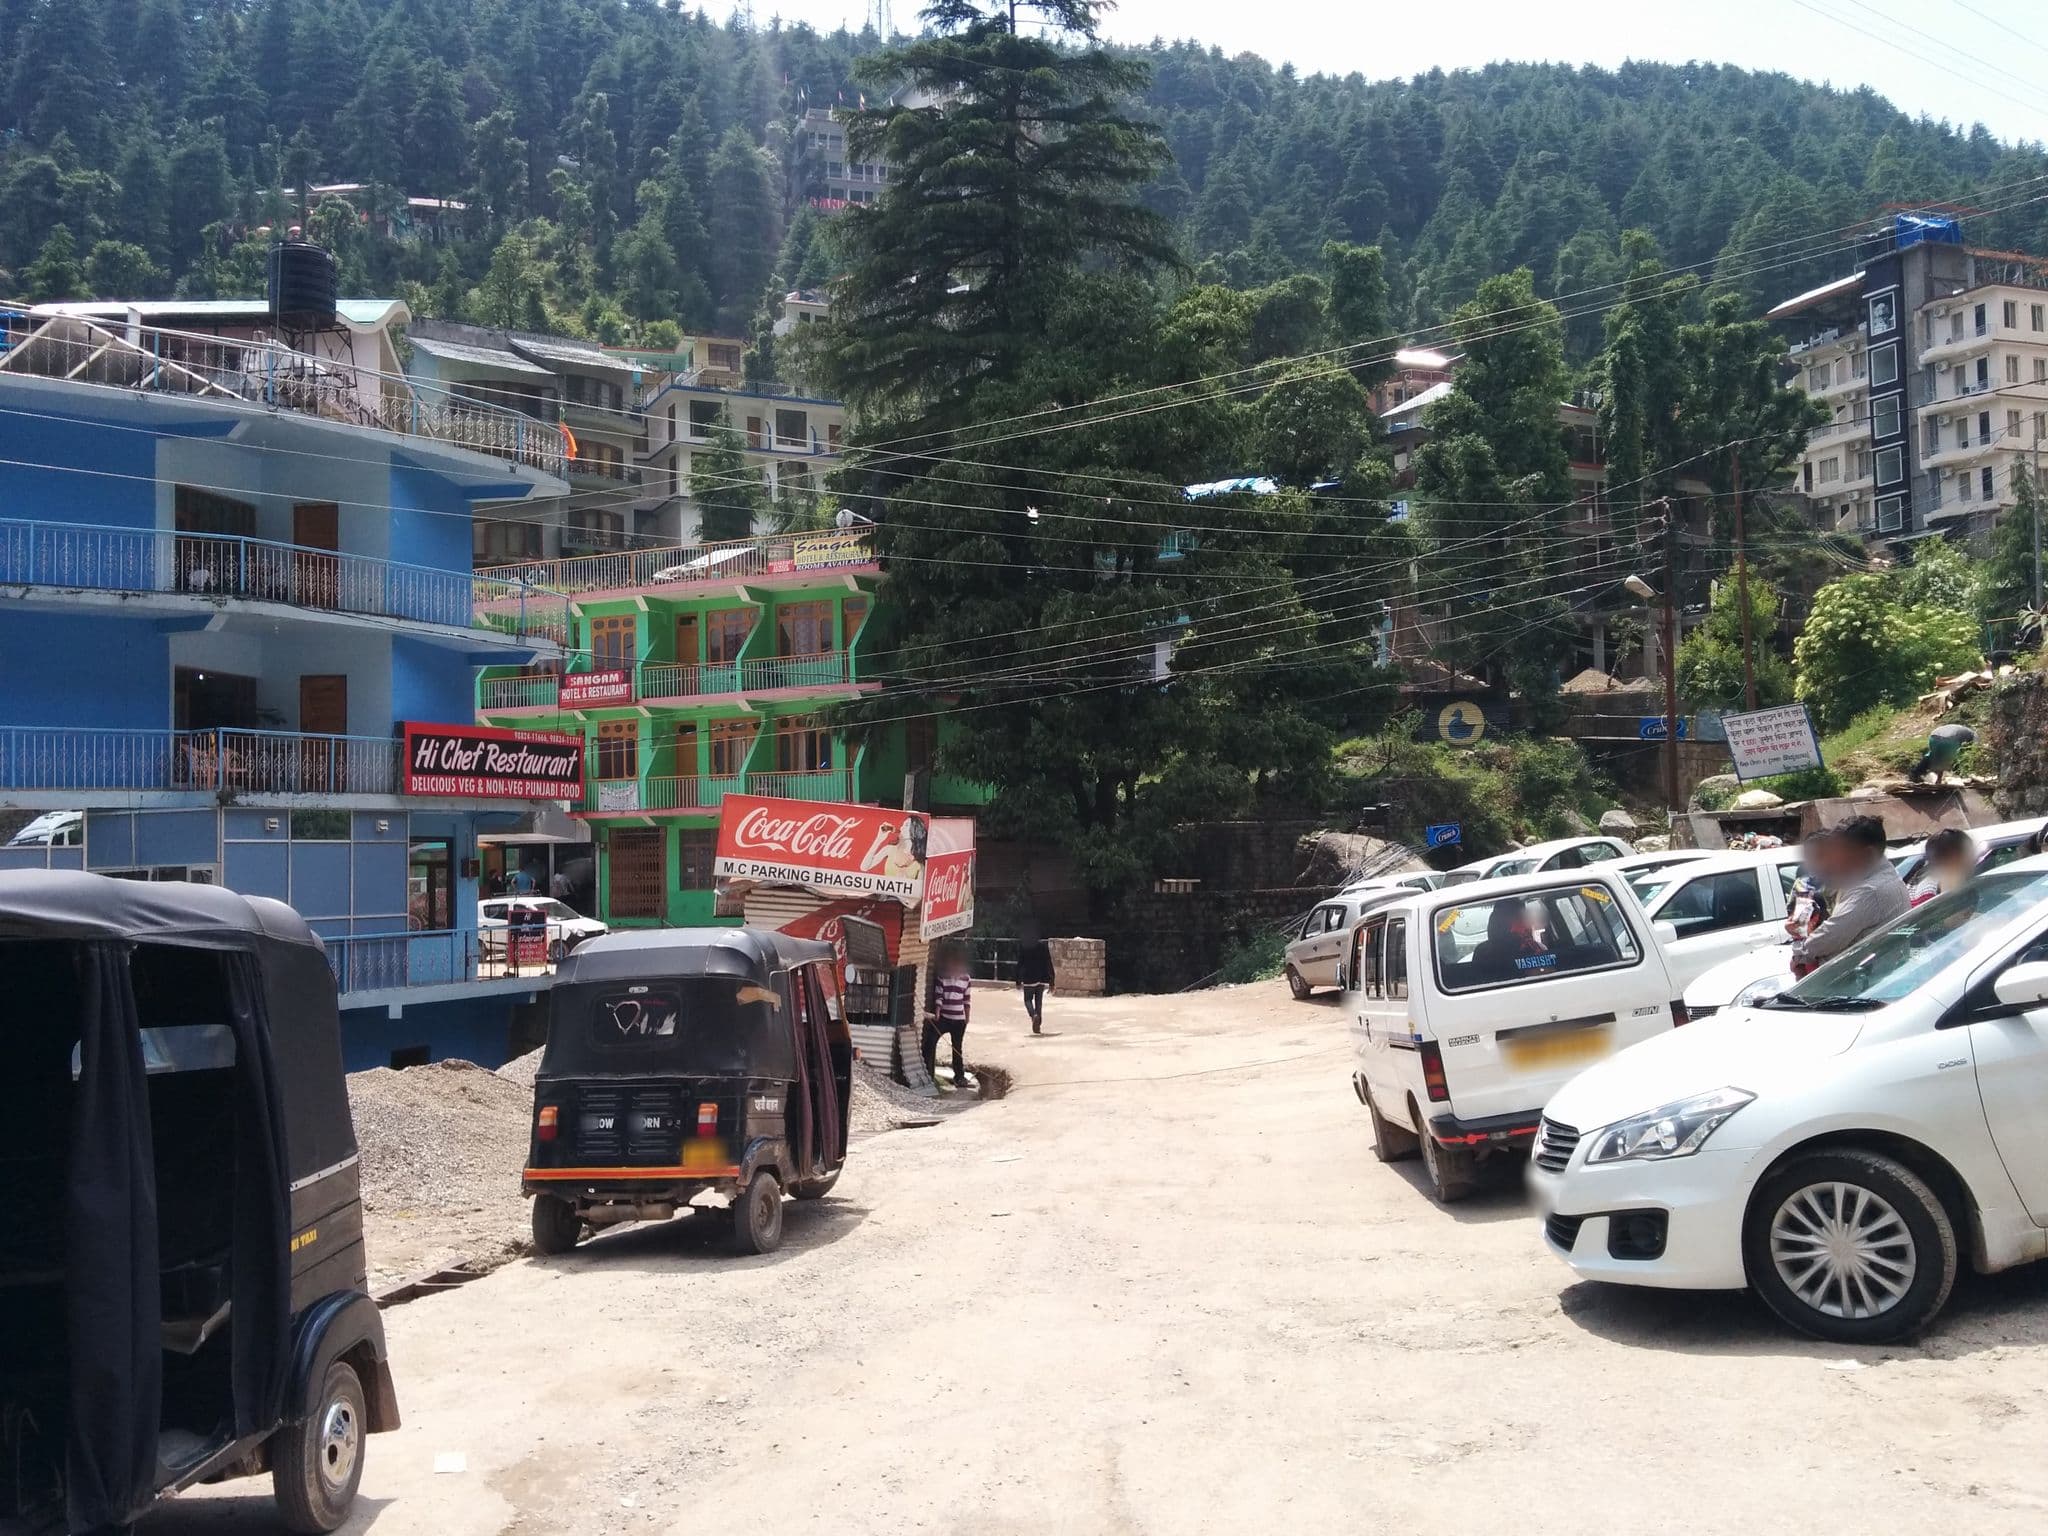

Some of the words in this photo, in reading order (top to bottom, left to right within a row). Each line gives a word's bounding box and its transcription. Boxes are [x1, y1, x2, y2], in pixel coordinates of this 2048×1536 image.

[796, 562, 825, 571] ROOMS
[826, 559, 870, 568] AVAILABLE
[570, 673, 619, 687] SANGAM
[561, 688, 581, 700] HOTEL
[582, 686, 588, 698] &
[588, 683, 628, 698] RESTAURANT
[415, 738, 440, 769] Hi
[441, 738, 485, 771] Chef
[485, 743, 578, 777] Restaurant
[412, 776, 456, 793] DELICIOUS
[458, 777, 476, 793] VEG
[477, 779, 484, 794] &
[486, 780, 524, 795] NON-VEG
[525, 782, 559, 797] PUNJABI
[560, 783, 580, 798] FOOD
[735, 807, 864, 858] Coca-Cola
[723, 861, 747, 875] M.C
[750, 864, 811, 882] PARKING
[814, 871, 872, 890] BHAGSU
[876, 880, 913, 895] NATH
[1514, 954, 1557, 969] VASHISHT
